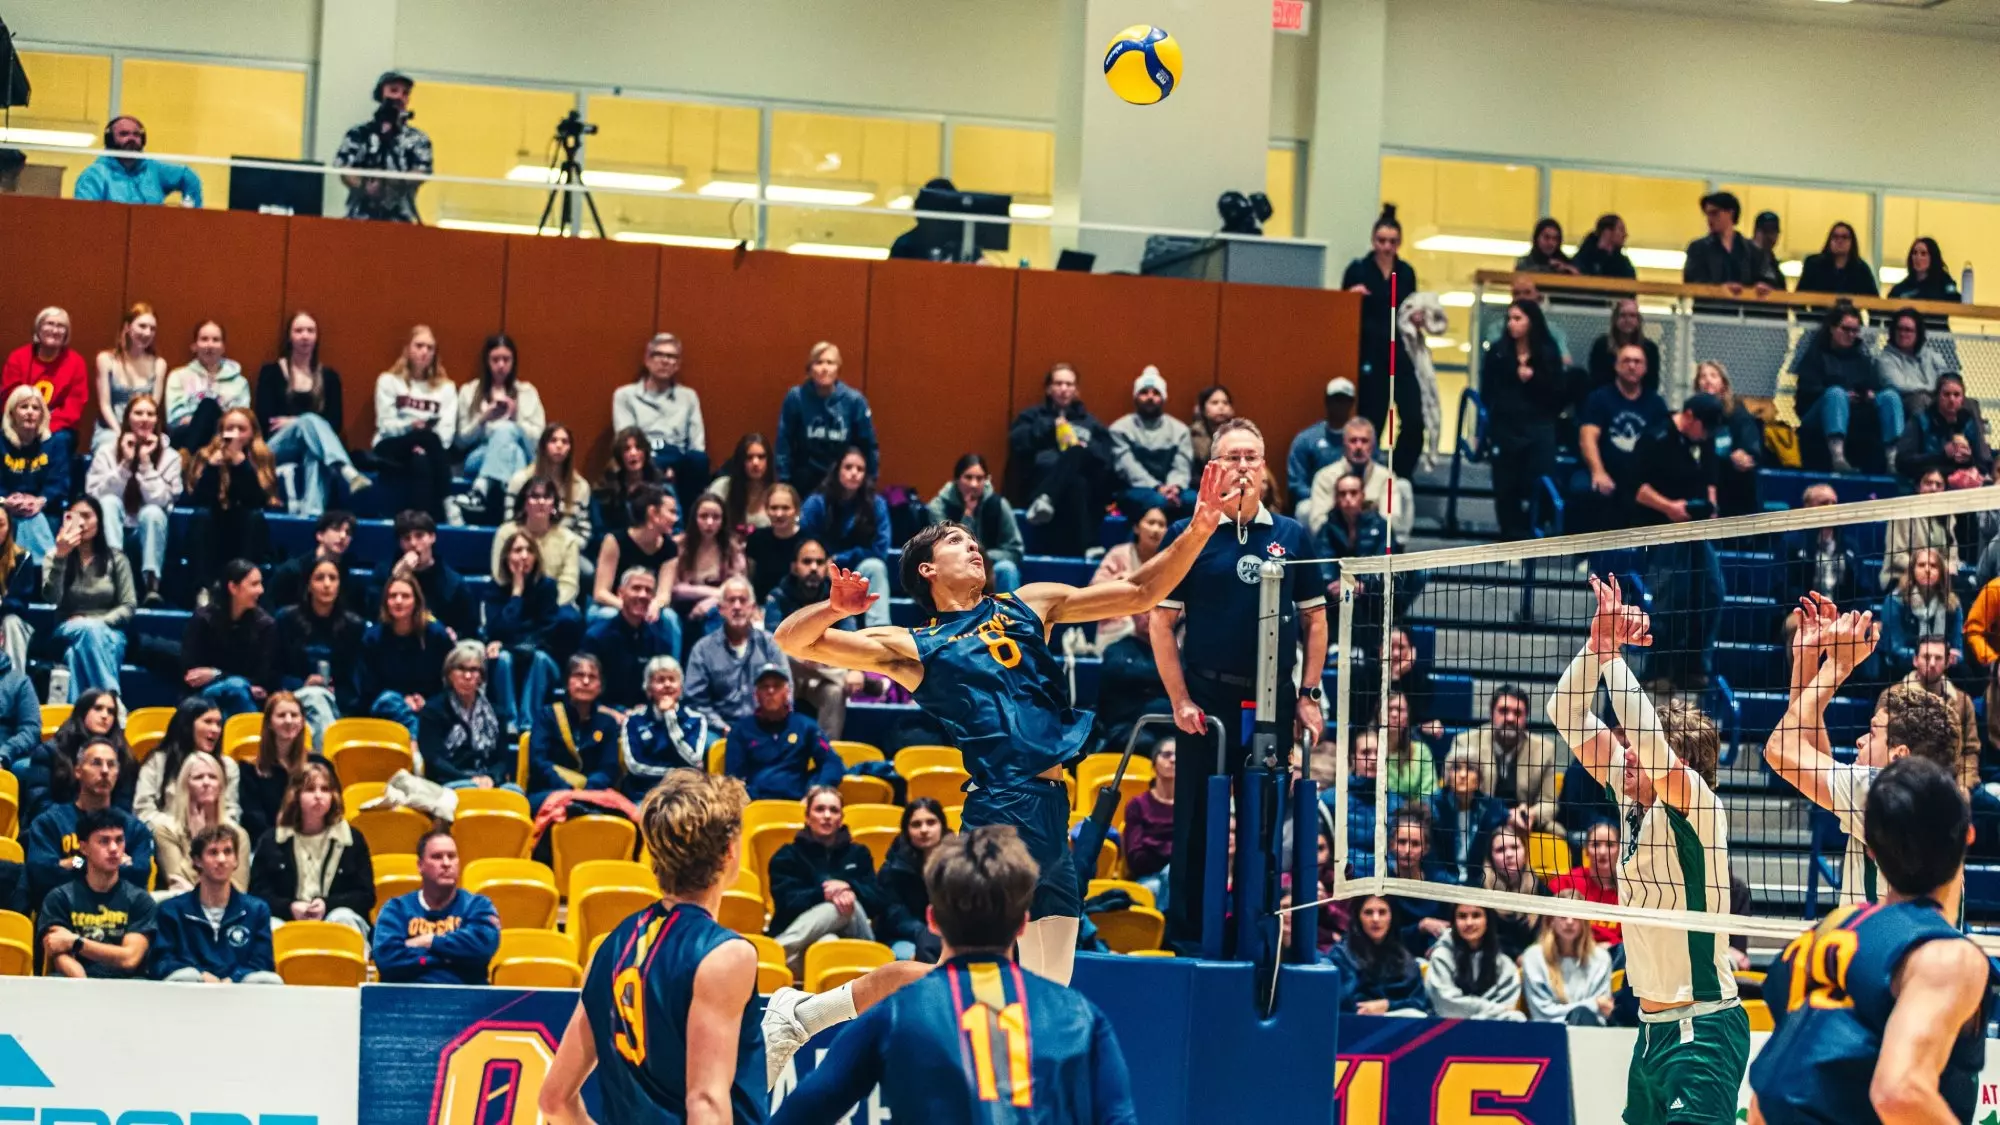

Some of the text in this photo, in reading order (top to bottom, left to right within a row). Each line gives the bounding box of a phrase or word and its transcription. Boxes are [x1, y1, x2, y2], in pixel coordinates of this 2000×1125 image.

[978, 628, 1023, 669] 8
[613, 966, 646, 1067] 9
[961, 1001, 1032, 1107] 11
